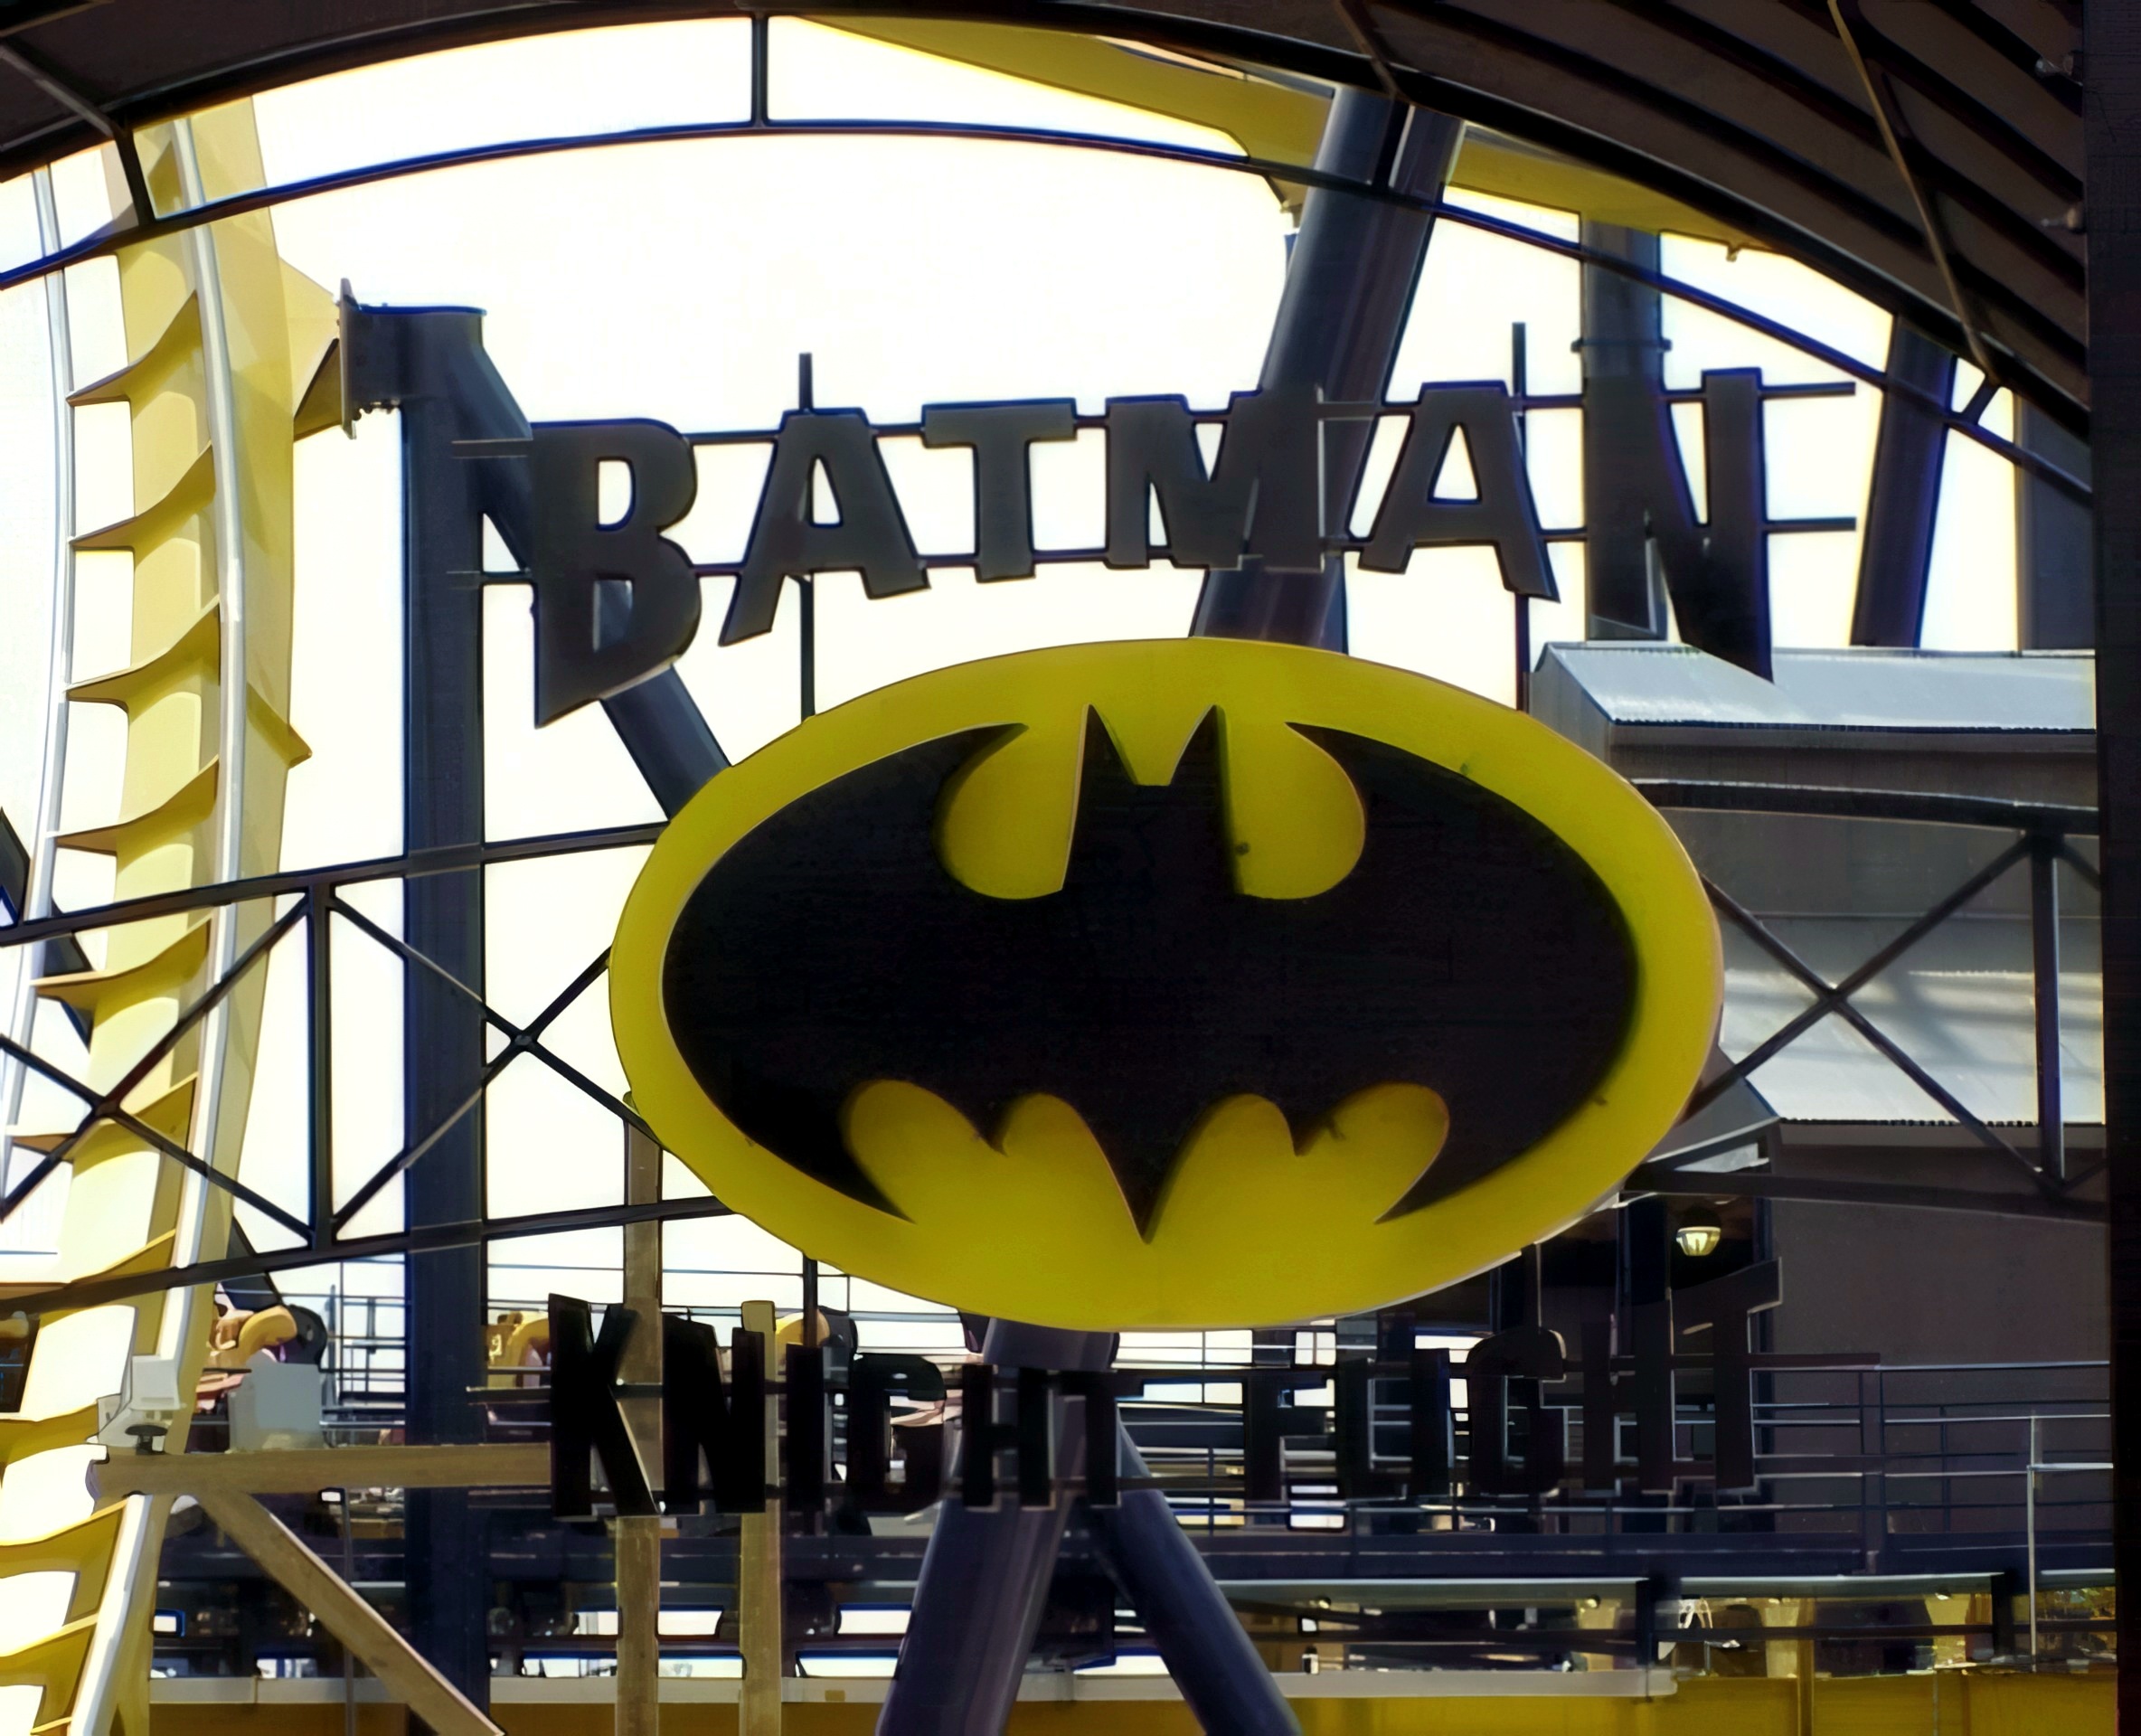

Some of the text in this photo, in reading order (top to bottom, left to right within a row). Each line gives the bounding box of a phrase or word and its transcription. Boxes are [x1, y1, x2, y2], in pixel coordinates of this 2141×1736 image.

[532, 367, 1774, 727] BATMAN
[549, 1257, 1782, 1518] KNIGHT FLIGHT
